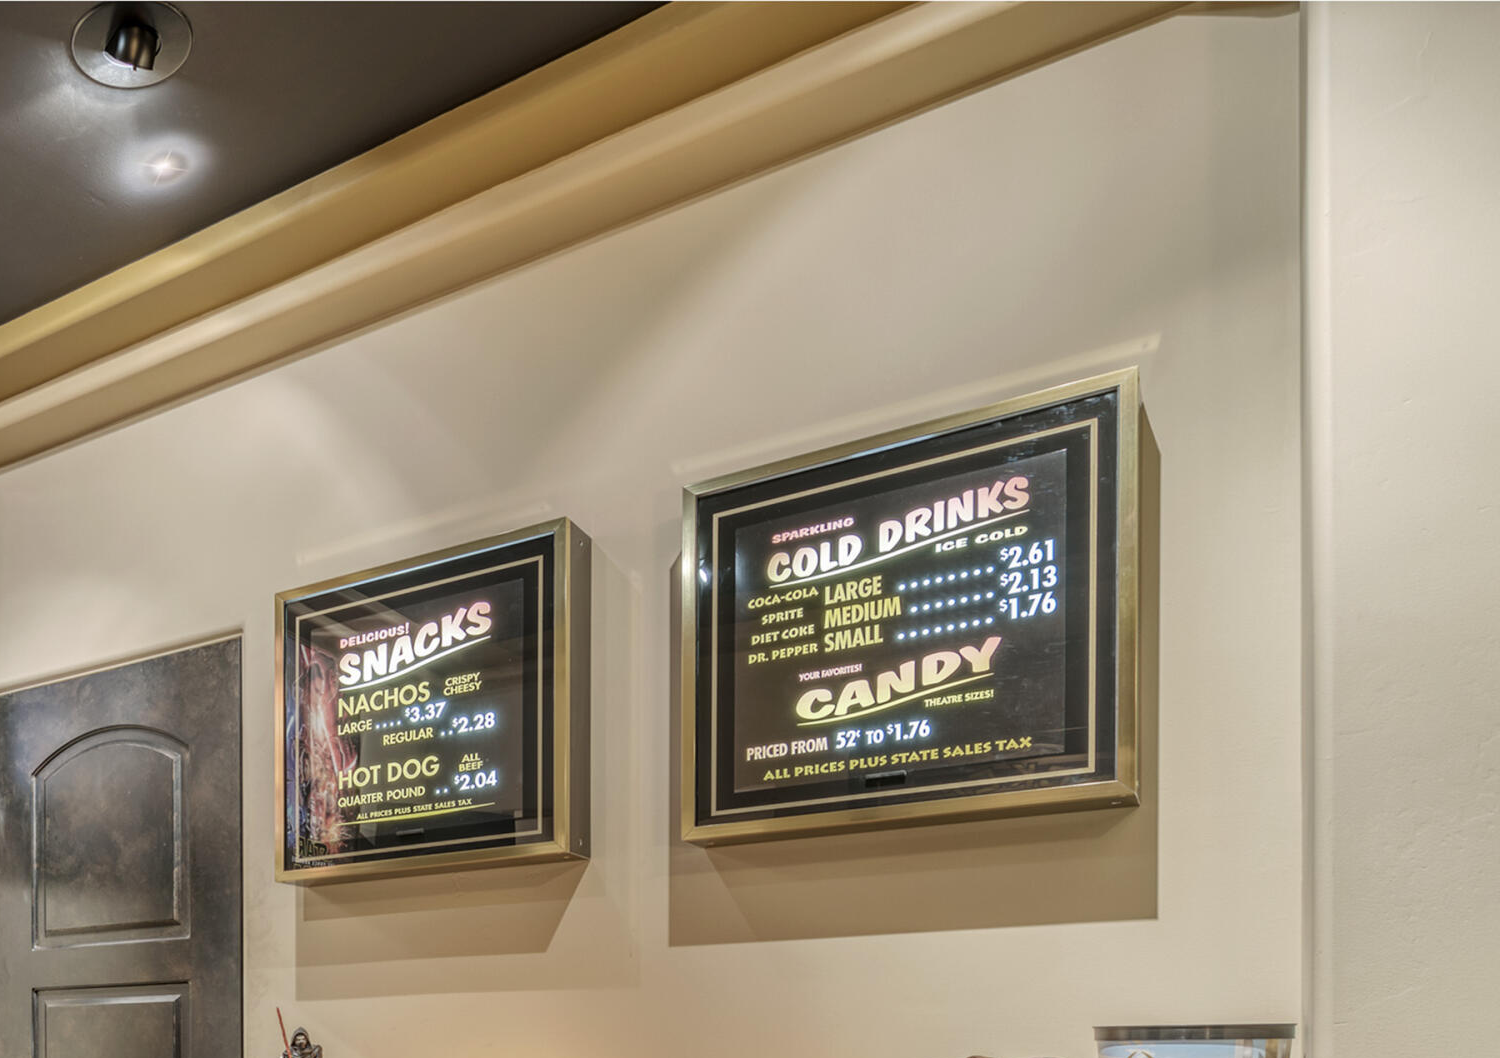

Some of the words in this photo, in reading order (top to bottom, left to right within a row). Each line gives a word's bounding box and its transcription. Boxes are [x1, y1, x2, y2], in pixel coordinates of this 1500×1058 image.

[767, 535, 863, 582] COLD
[879, 476, 1031, 553] DRINKS
[772, 517, 854, 544] SPARKLING
[935, 537, 968, 553] ICE
[975, 526, 1028, 544] COLD
[824, 575, 882, 605] LARGE
[1000, 539, 1055, 569] $2.61
[748, 586, 819, 609] COCA-COLA
[823, 596, 901, 629] MEDIUM
[1000, 565, 1058, 595] $2.13
[761, 607, 804, 625] SPRITE
[824, 624, 884, 653] SMALL
[999, 591, 1057, 620] $1.76
[338, 601, 492, 685] SNACKS
[340, 622, 410, 649] DELICIOUS!
[751, 630, 779, 646] DIET
[781, 623, 815, 640] COKE
[748, 652, 769, 665] DR.
[771, 643, 818, 661] PEPPER
[445, 671, 481, 687] CRISPY
[795, 636, 1002, 721] CANDY
[799, 670, 820, 682] YOUR
[821, 663, 863, 678] FAVORITES!
[338, 681, 431, 718] NACHOS
[443, 681, 482, 696] CHEESY
[924, 693, 963, 708] THEATRE
[964, 689, 994, 703] SIZES!
[338, 719, 373, 736] LARGE
[404, 701, 447, 723] $3.37
[383, 727, 433, 746] REGULAR
[452, 712, 496, 734] $2.28
[746, 742, 788, 761] PRICED
[791, 736, 828, 756] FROM
[865, 729, 884, 744] TO
[886, 719, 931, 741] $1.76
[458, 761, 483, 772] BEEF
[461, 753, 481, 763] ALL
[763, 768, 790, 781] ALL
[794, 761, 845, 777] PRICES
[849, 755, 887, 770] PLUS
[891, 748, 939, 765] STATE
[943, 742, 992, 758] SALES
[995, 736, 1032, 751] TAX
[338, 764, 381, 790] HOT
[387, 755, 440, 783] DOG
[338, 791, 383, 808] QUARTER
[387, 786, 425, 801] POUND
[453, 770, 498, 791] $2.04
[356, 811, 369, 820] ALL
[369, 808, 393, 818] PRICES
[394, 805, 411, 815] PLUS
[412, 803, 433, 813] STATE
[434, 801, 456, 811] SALES
[457, 799, 472, 808] TAX
